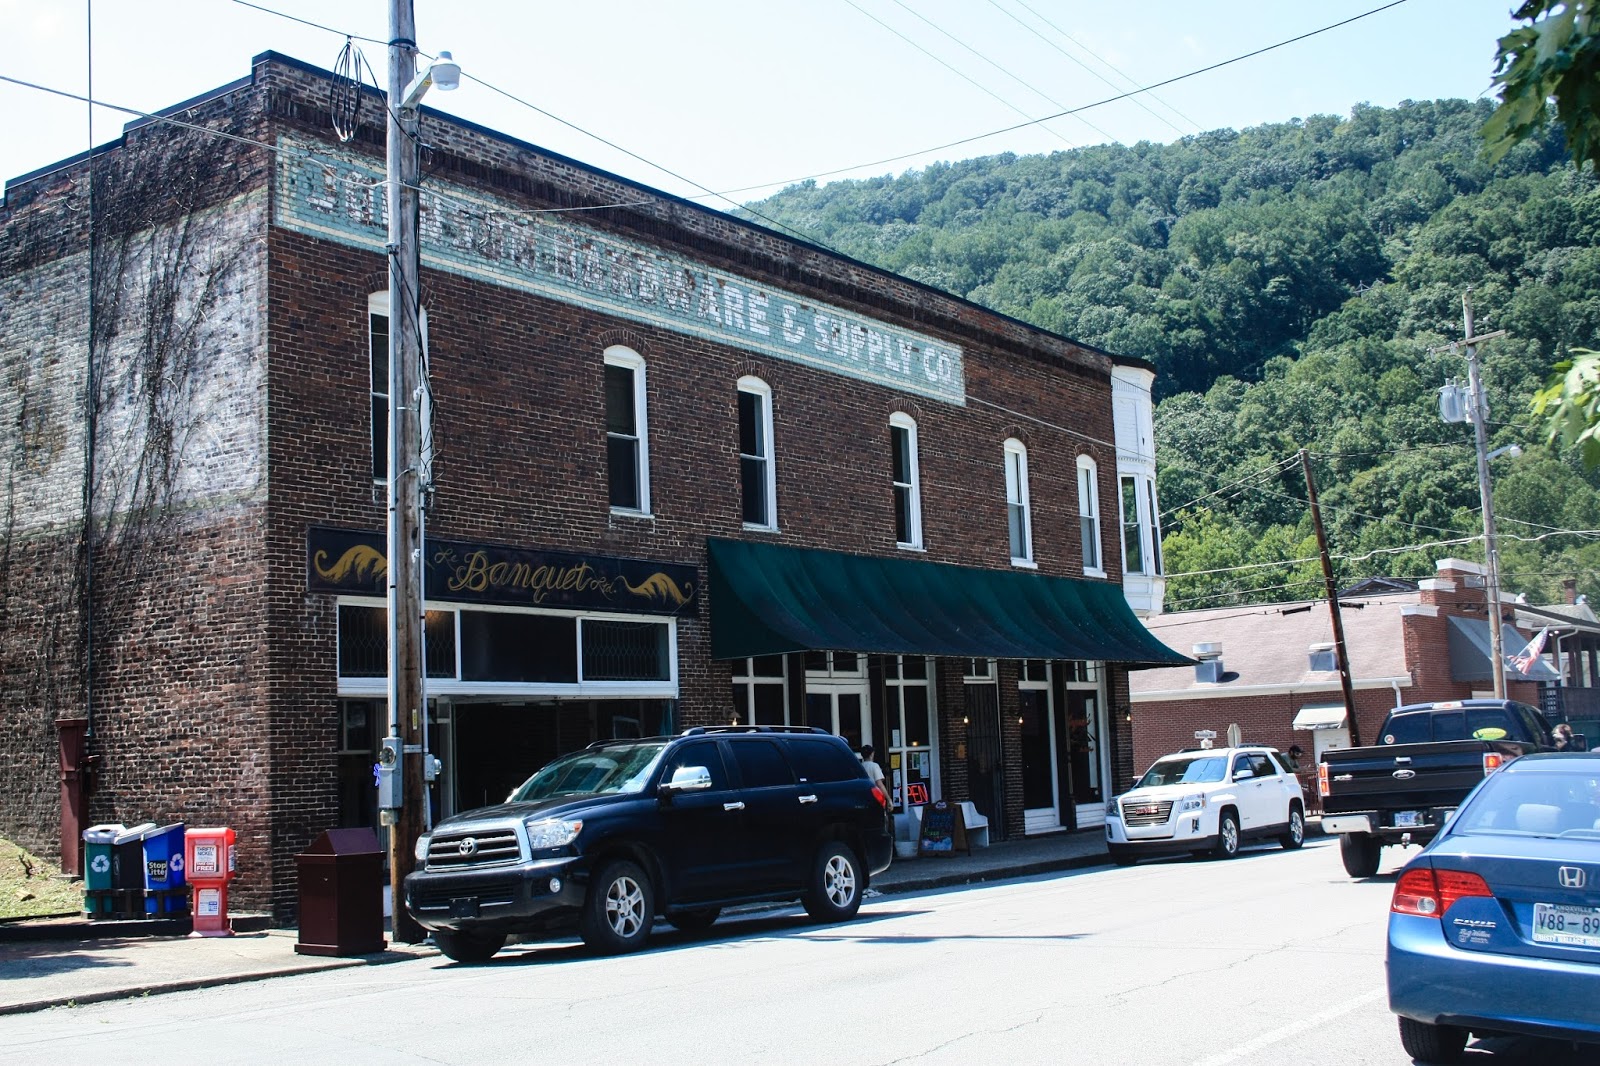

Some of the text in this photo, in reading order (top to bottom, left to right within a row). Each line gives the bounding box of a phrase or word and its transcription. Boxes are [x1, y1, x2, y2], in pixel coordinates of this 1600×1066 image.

[814, 315, 913, 376] SUPPLY
[922, 347, 952, 383] CO
[448, 550, 592, 603] Banquet
[898, 784, 928, 804] PEN
[149, 861, 166, 869] Stop
